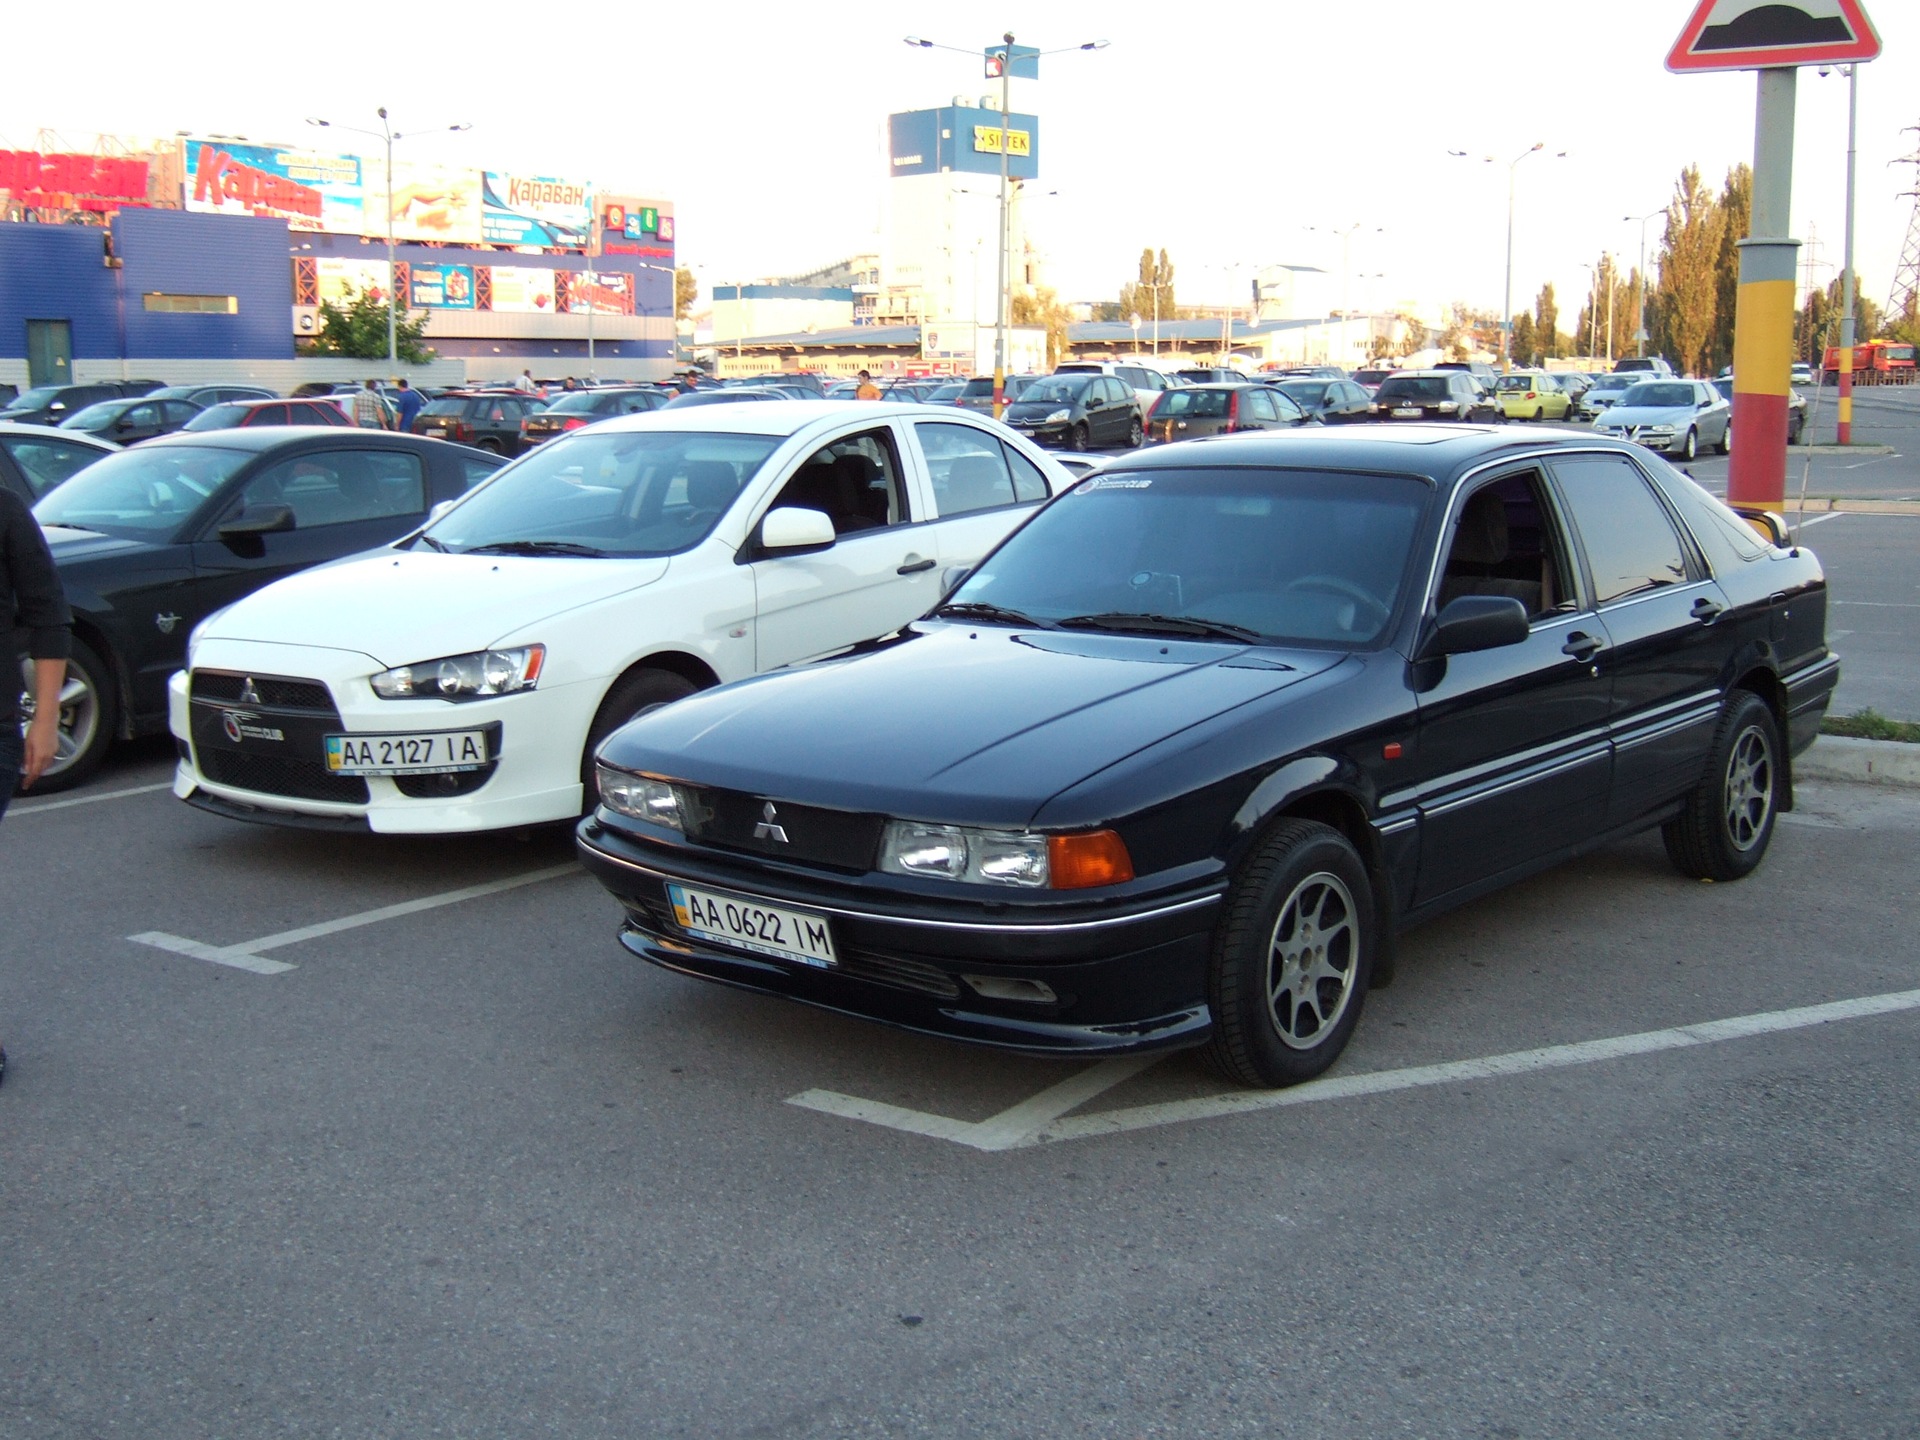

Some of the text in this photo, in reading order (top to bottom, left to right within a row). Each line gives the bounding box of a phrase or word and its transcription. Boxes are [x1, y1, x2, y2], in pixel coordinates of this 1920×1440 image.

[989, 133, 1027, 150] SITEK
[193, 143, 323, 219] Караван
[509, 177, 584, 207] Караван
[344, 736, 479, 765] AA 2127 IA
[690, 894, 831, 956] AA 0622 IM
